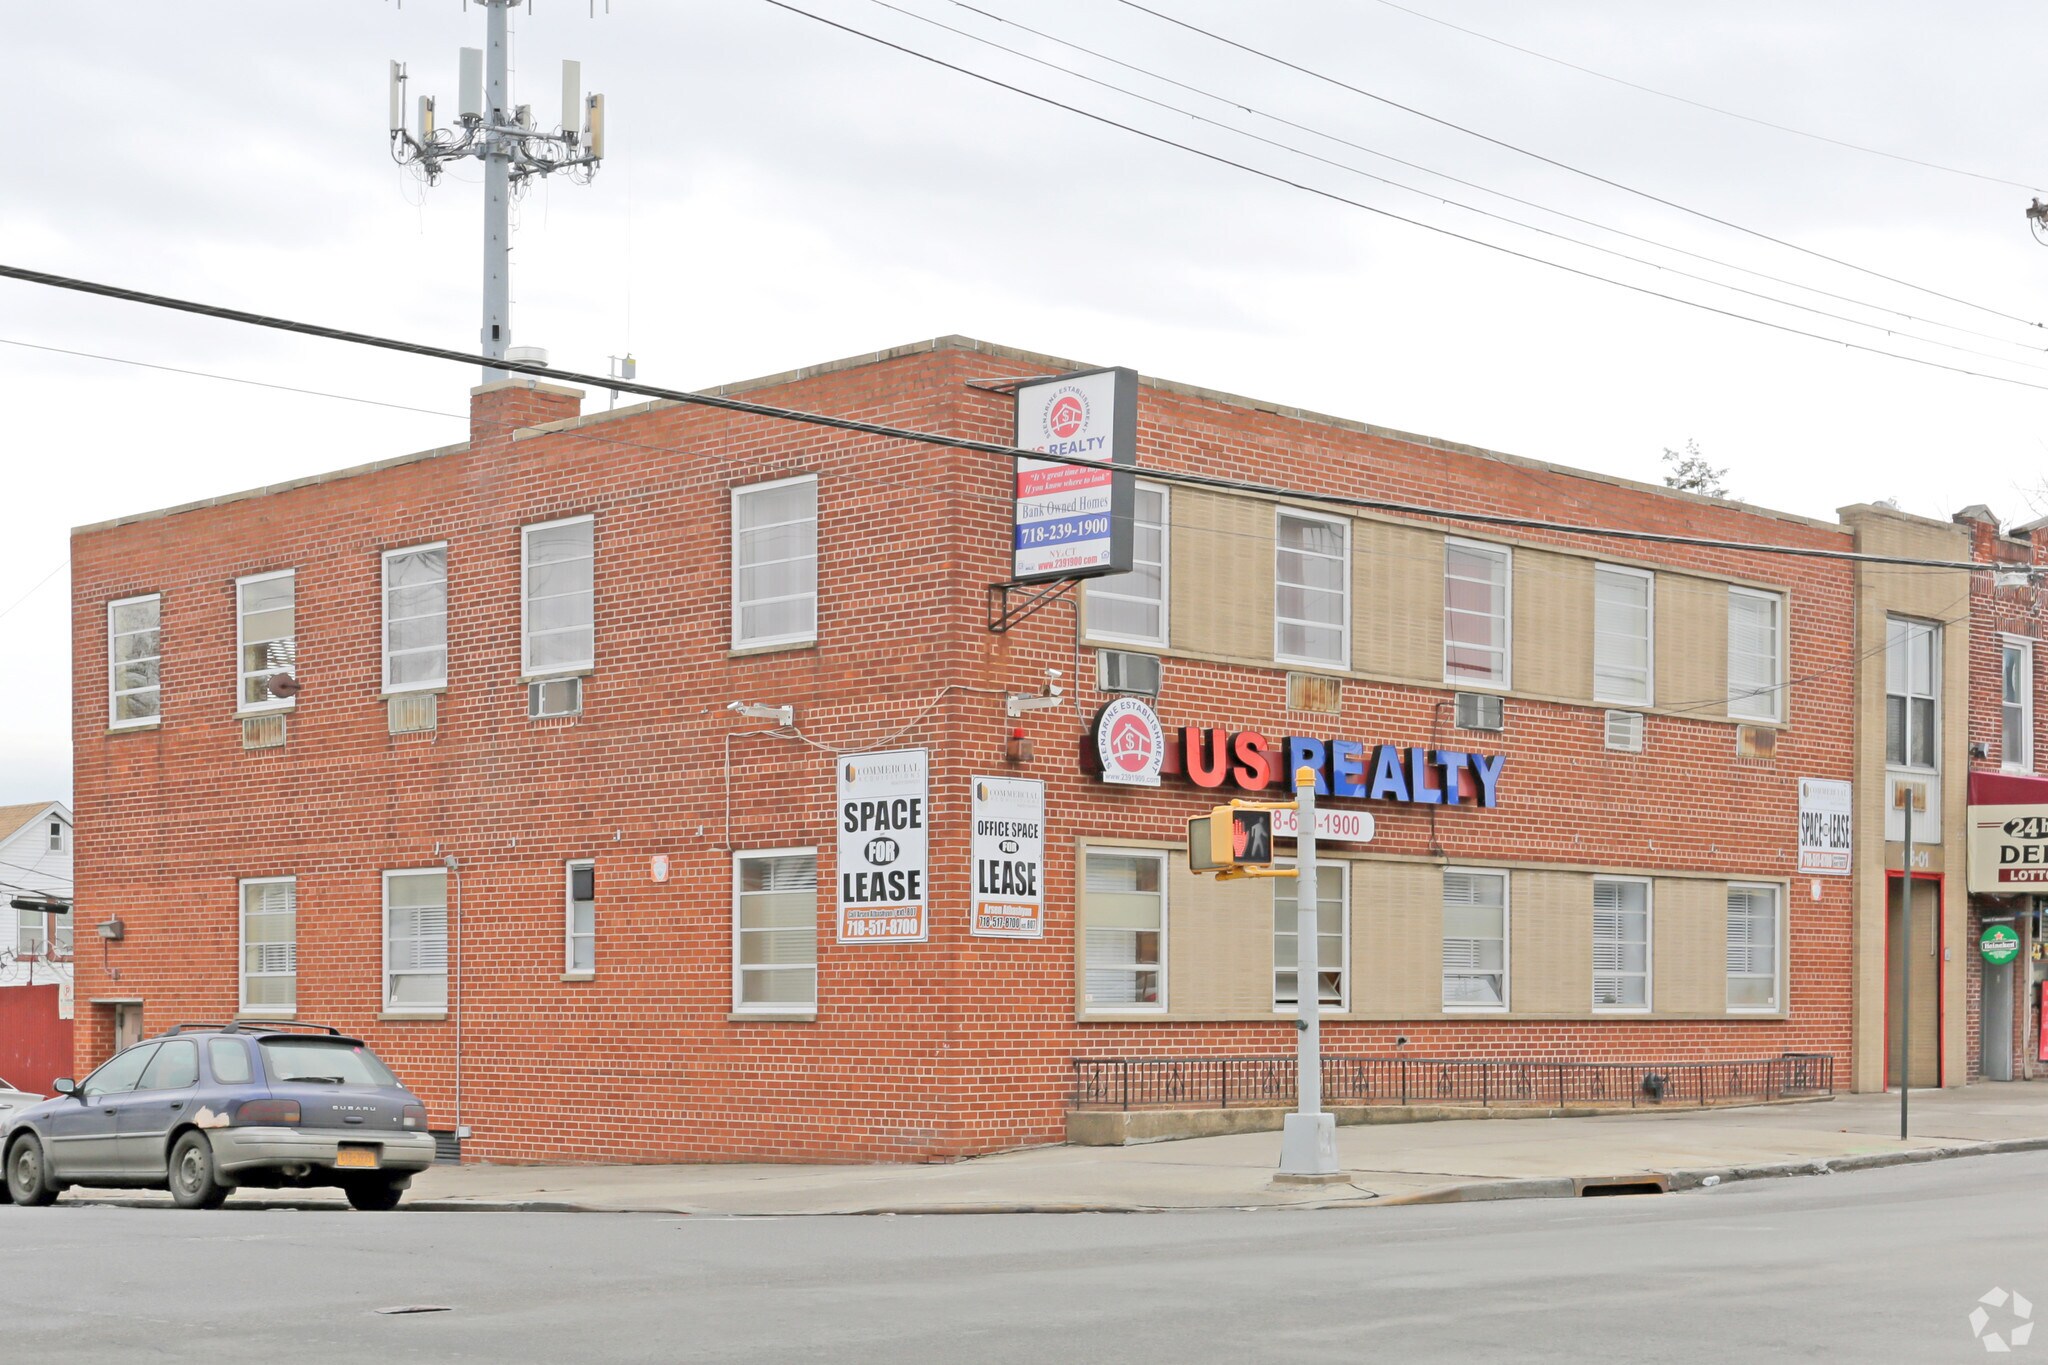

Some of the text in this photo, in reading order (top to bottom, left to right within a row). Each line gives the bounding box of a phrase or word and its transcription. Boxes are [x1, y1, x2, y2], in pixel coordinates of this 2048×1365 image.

[1049, 436, 1105, 456] REALTY
[1031, 484, 1044, 493] you
[1045, 481, 1063, 490] know
[1063, 478, 1083, 487] where
[1022, 496, 1108, 519] Bank Owned Homes
[1021, 517, 1108, 544] 718-239-1900
[1099, 701, 1162, 773] SEENARINE ESTABLISHMENT
[857, 762, 920, 776] COMMERCIAL
[1179, 726, 1507, 808] US REALTY
[844, 798, 922, 833] SPACE
[977, 820, 1039, 839] OFFICE SPACE
[1801, 811, 1850, 849] SPACE LEASE
[868, 840, 895, 863] FOR
[1002, 841, 1017, 852] FOR
[843, 869, 922, 903] LEASE
[978, 859, 1037, 896] LEASE
[2009, 869, 2048, 882] LOTT
[846, 918, 918, 936] 718-517-8700
[979, 916, 1020, 928] 718-517-8700
[1984, 941, 2016, 949] Heineken
